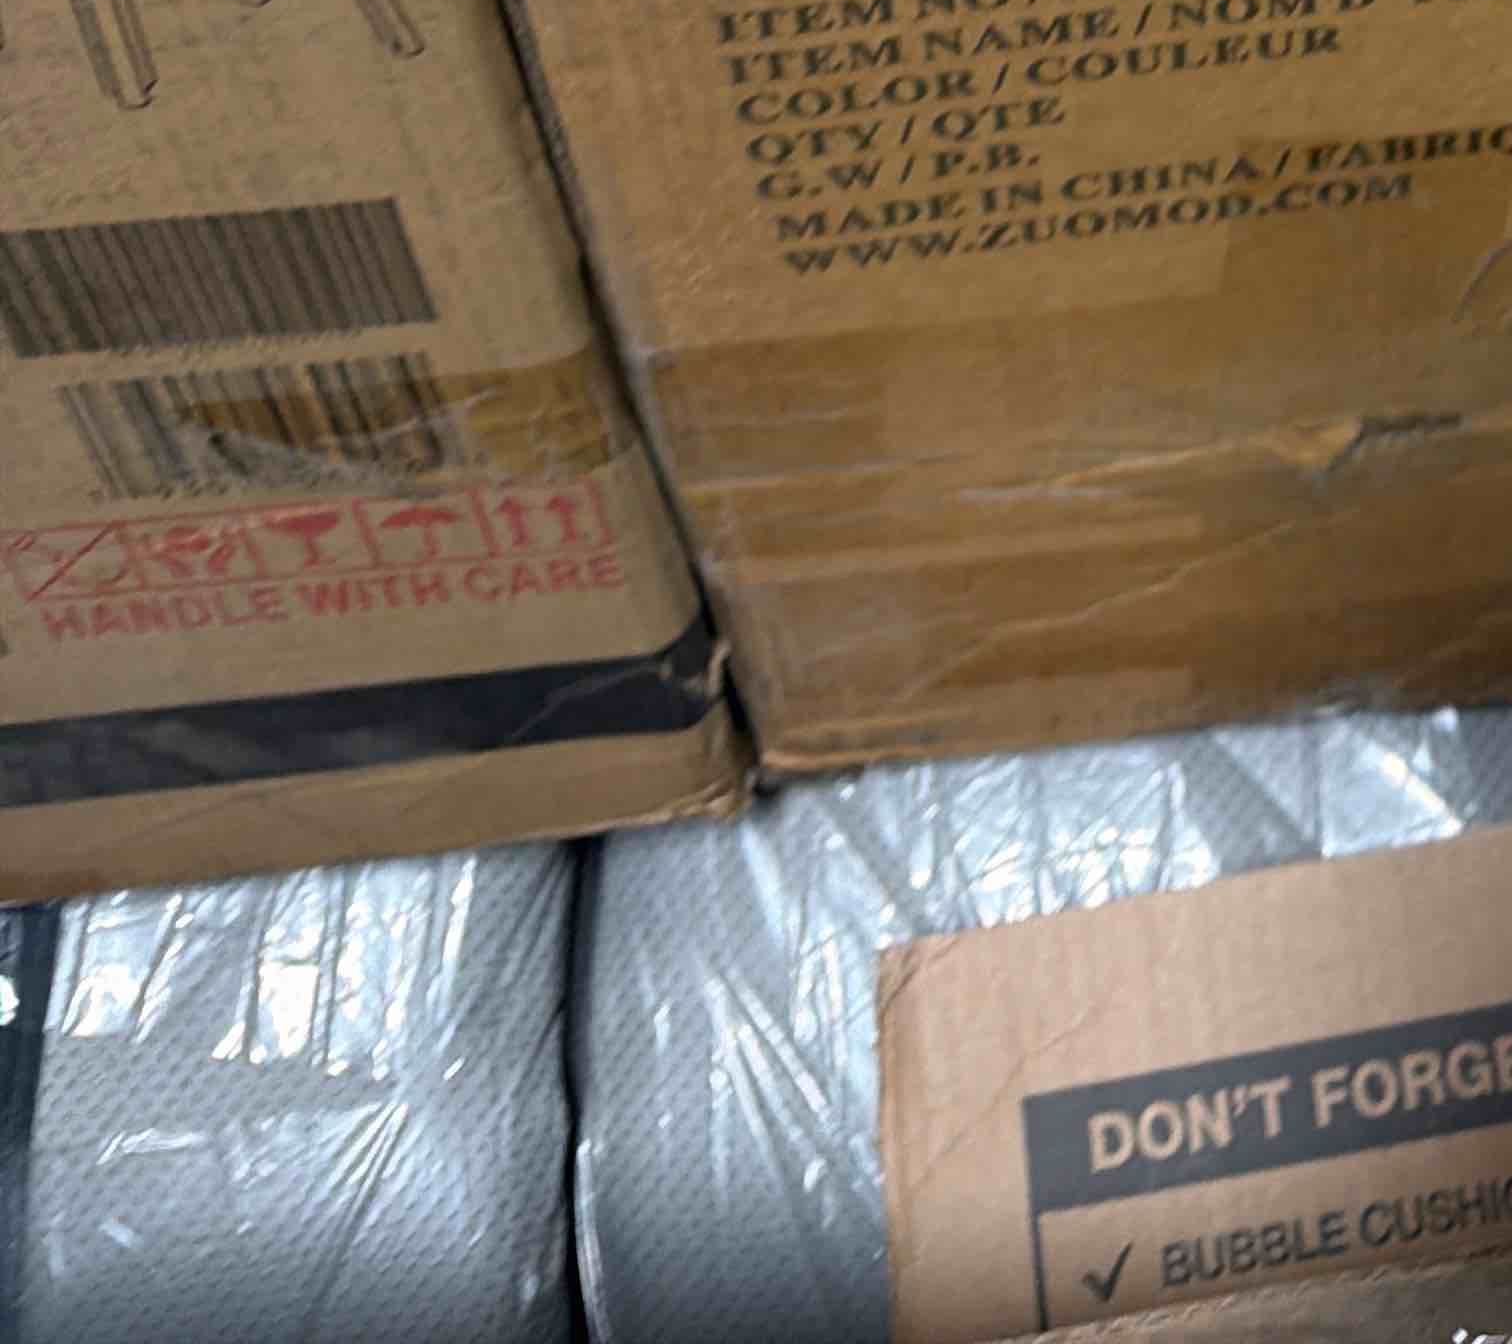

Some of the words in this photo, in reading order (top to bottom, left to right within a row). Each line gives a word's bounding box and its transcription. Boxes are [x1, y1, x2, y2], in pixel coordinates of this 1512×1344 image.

[721, 35, 904, 87] ITEM
[773, 190, 968, 244] MADE
[978, 179, 1046, 212] IN
[783, 173, 1414, 276] WWW.ZUOMOD.COM
[40, 584, 290, 642] HANDLE
[299, 566, 451, 619] WITH
[462, 552, 626, 602] CARE
[1086, 1075, 1294, 1174] DON'T
[1159, 1212, 1349, 1289] BUBBLE
